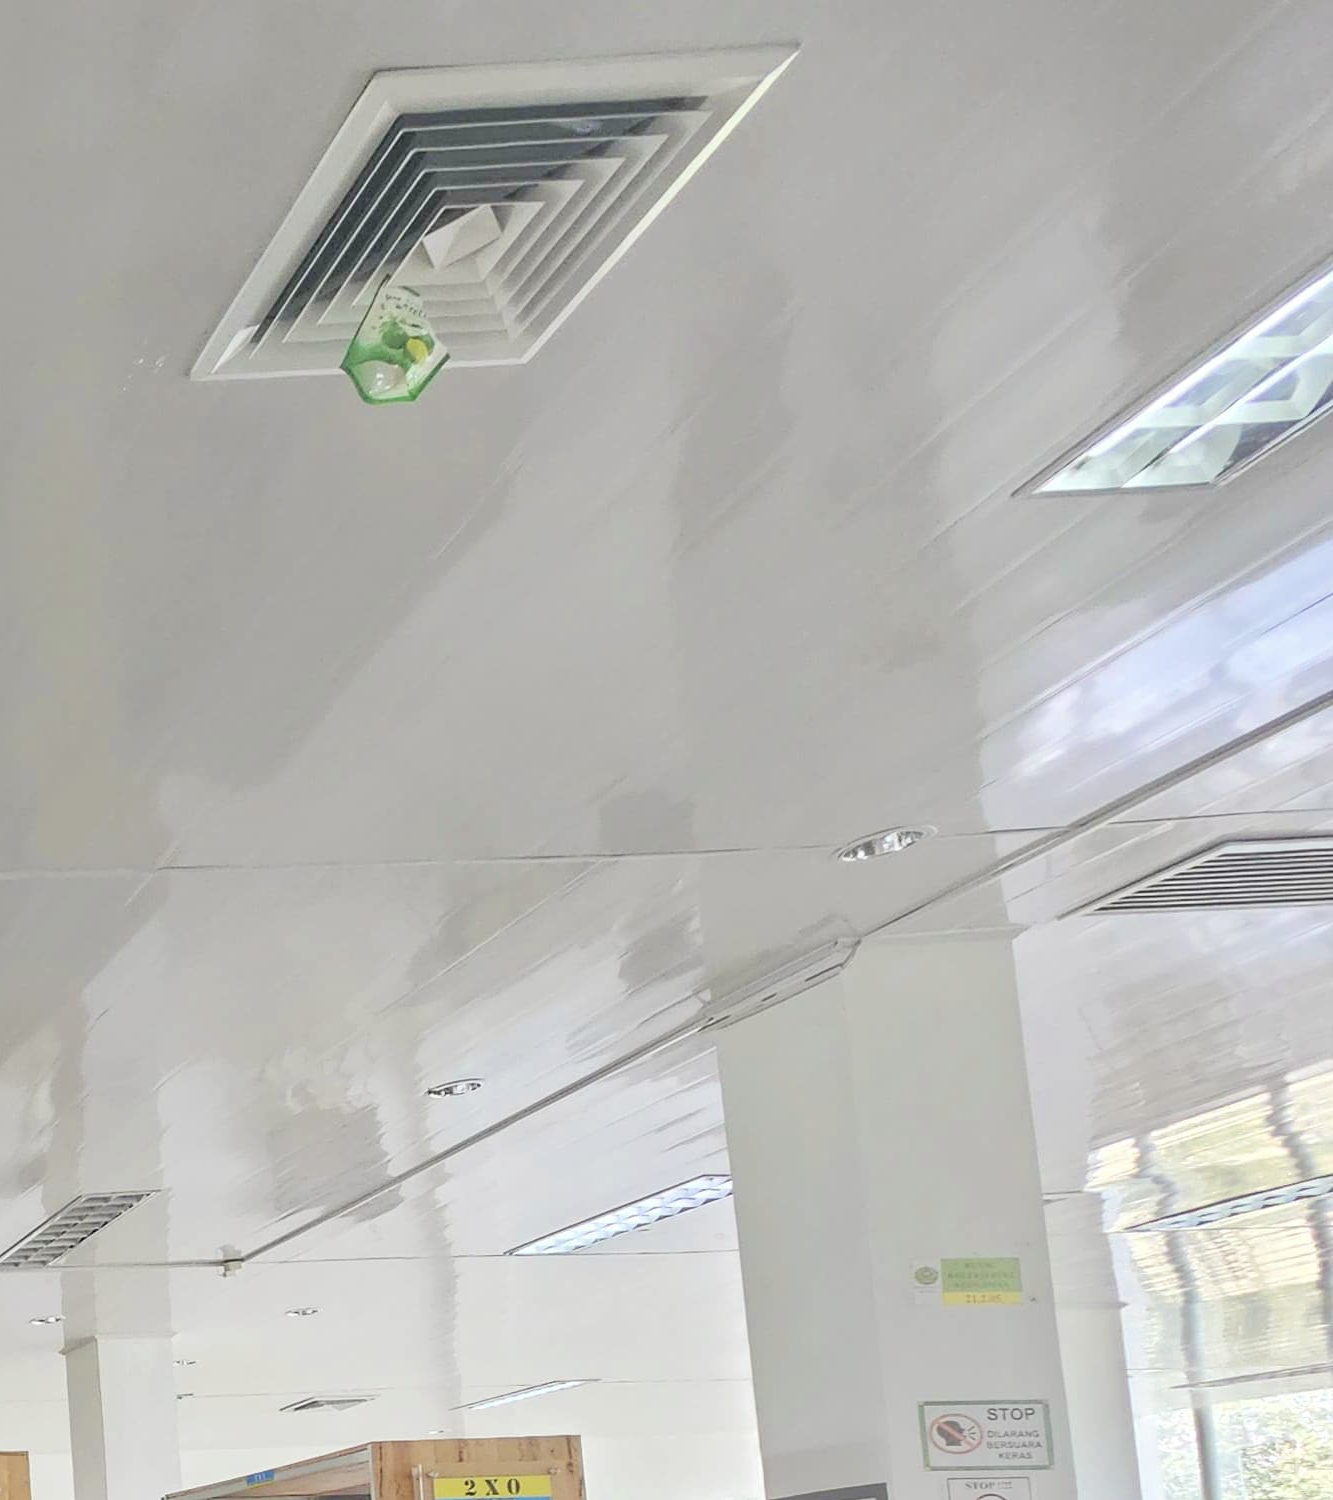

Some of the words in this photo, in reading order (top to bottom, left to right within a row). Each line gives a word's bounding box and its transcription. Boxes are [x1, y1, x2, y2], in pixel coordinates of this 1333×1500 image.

[986, 1407, 1036, 1421] STOP
[986, 1430, 1040, 1439] DILARANG
[986, 1440, 1043, 1450] BERSUARA
[464, 1479, 478, 1496] 2
[485, 1479, 500, 1496] X
[506, 1478, 521, 1495] 0
